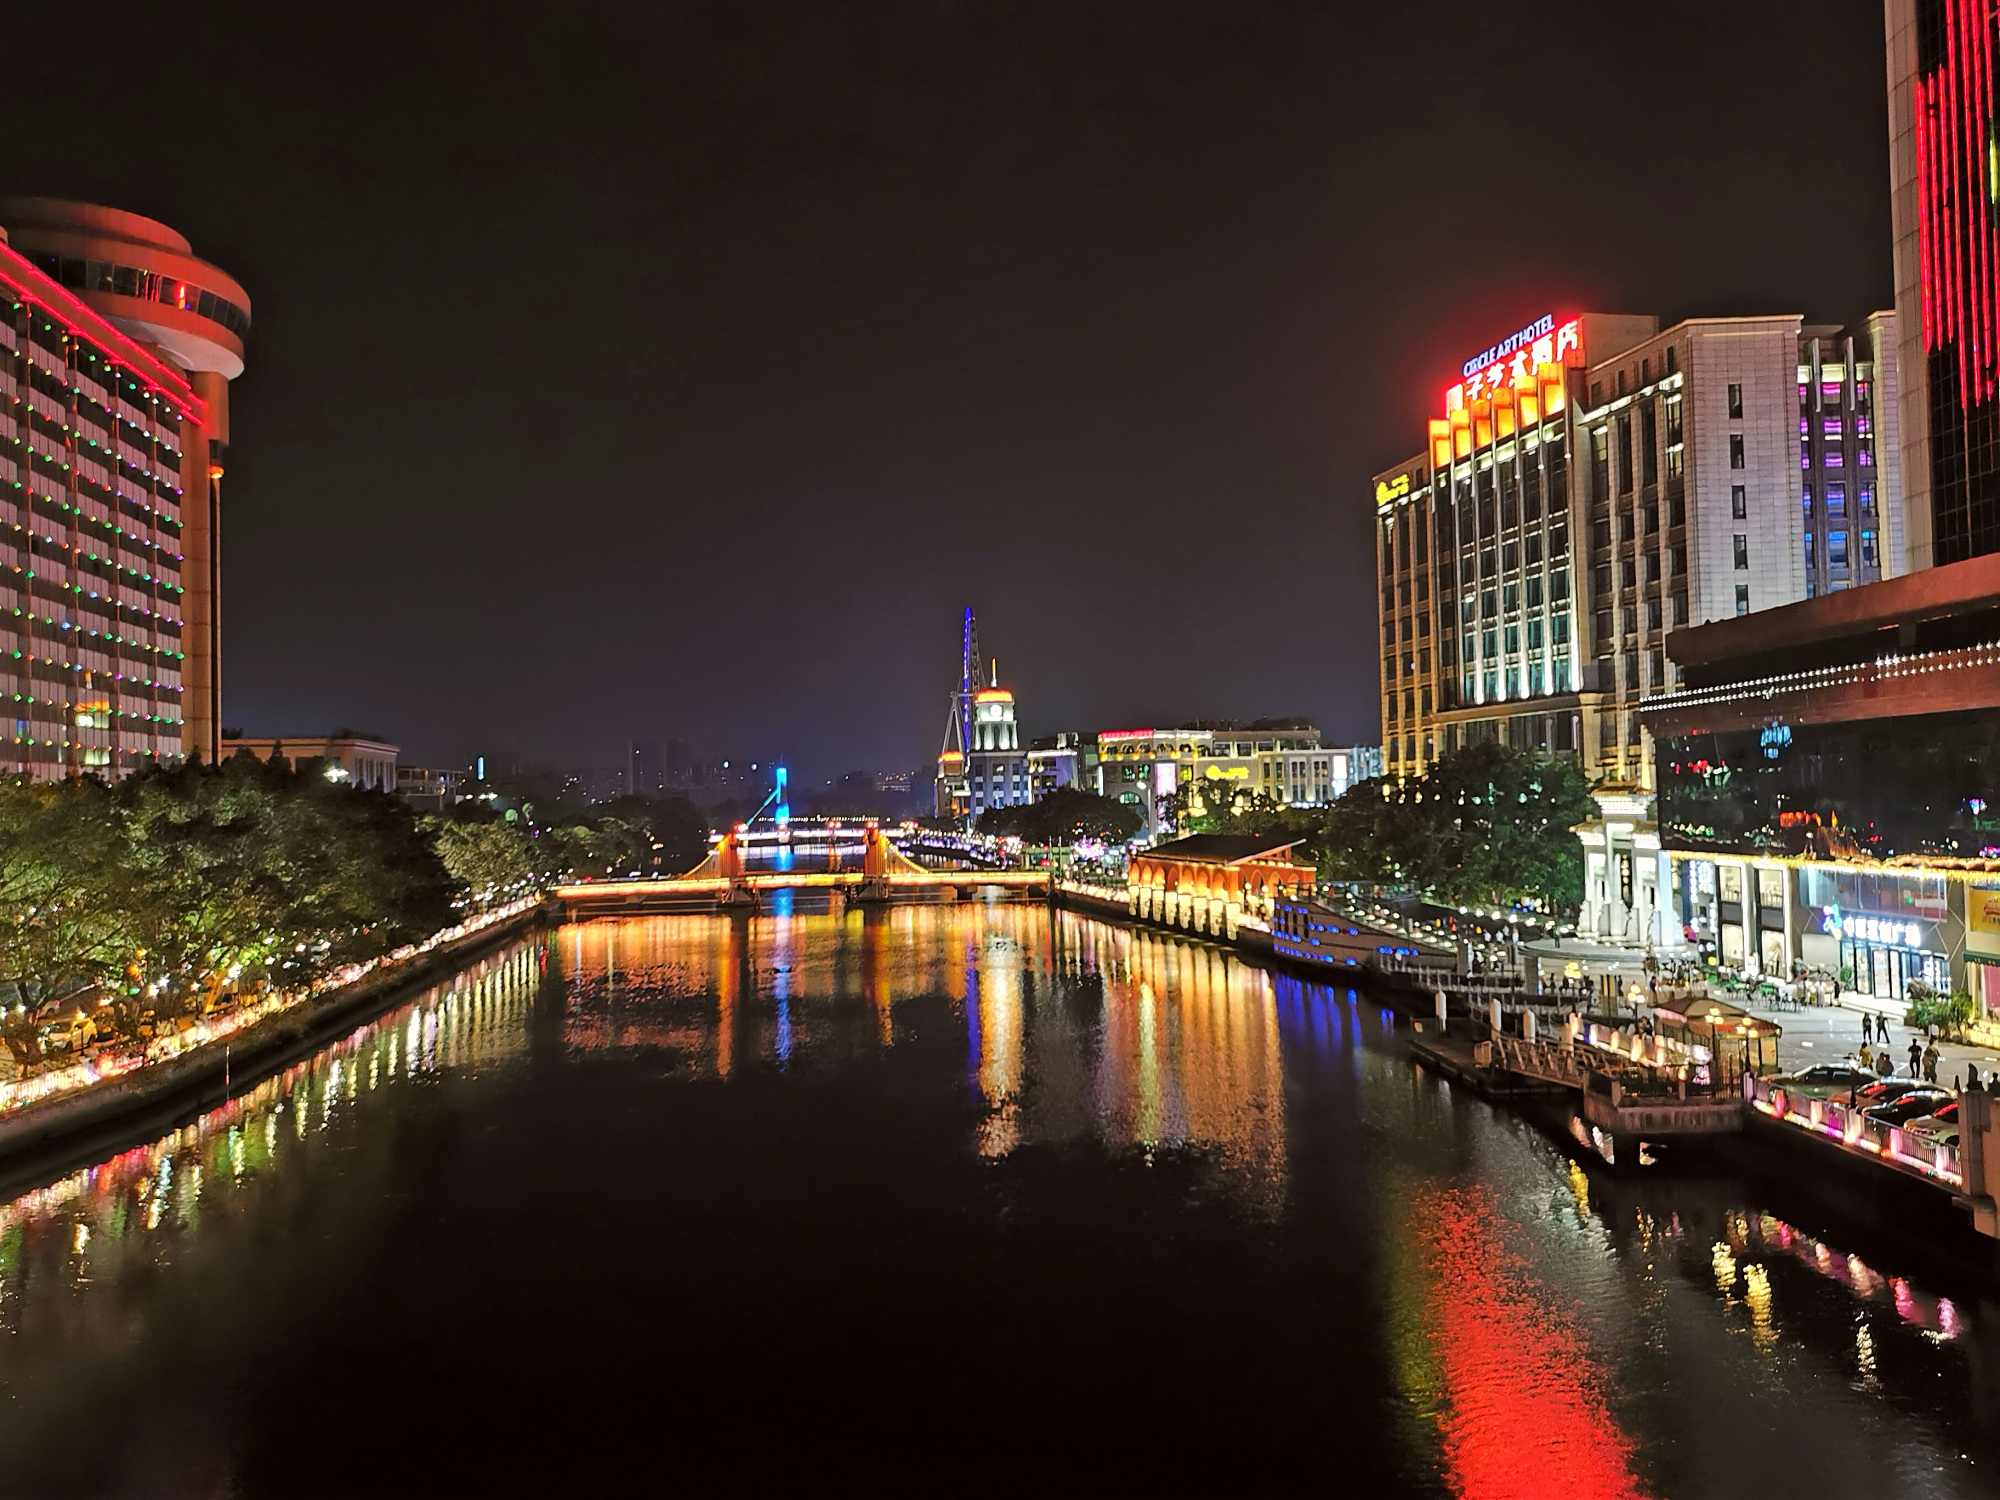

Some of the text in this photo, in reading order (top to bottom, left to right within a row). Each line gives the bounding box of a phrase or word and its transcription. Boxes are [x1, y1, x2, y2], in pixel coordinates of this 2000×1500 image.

[1463, 314, 1555, 377] CIRCLE ART HOTEL
